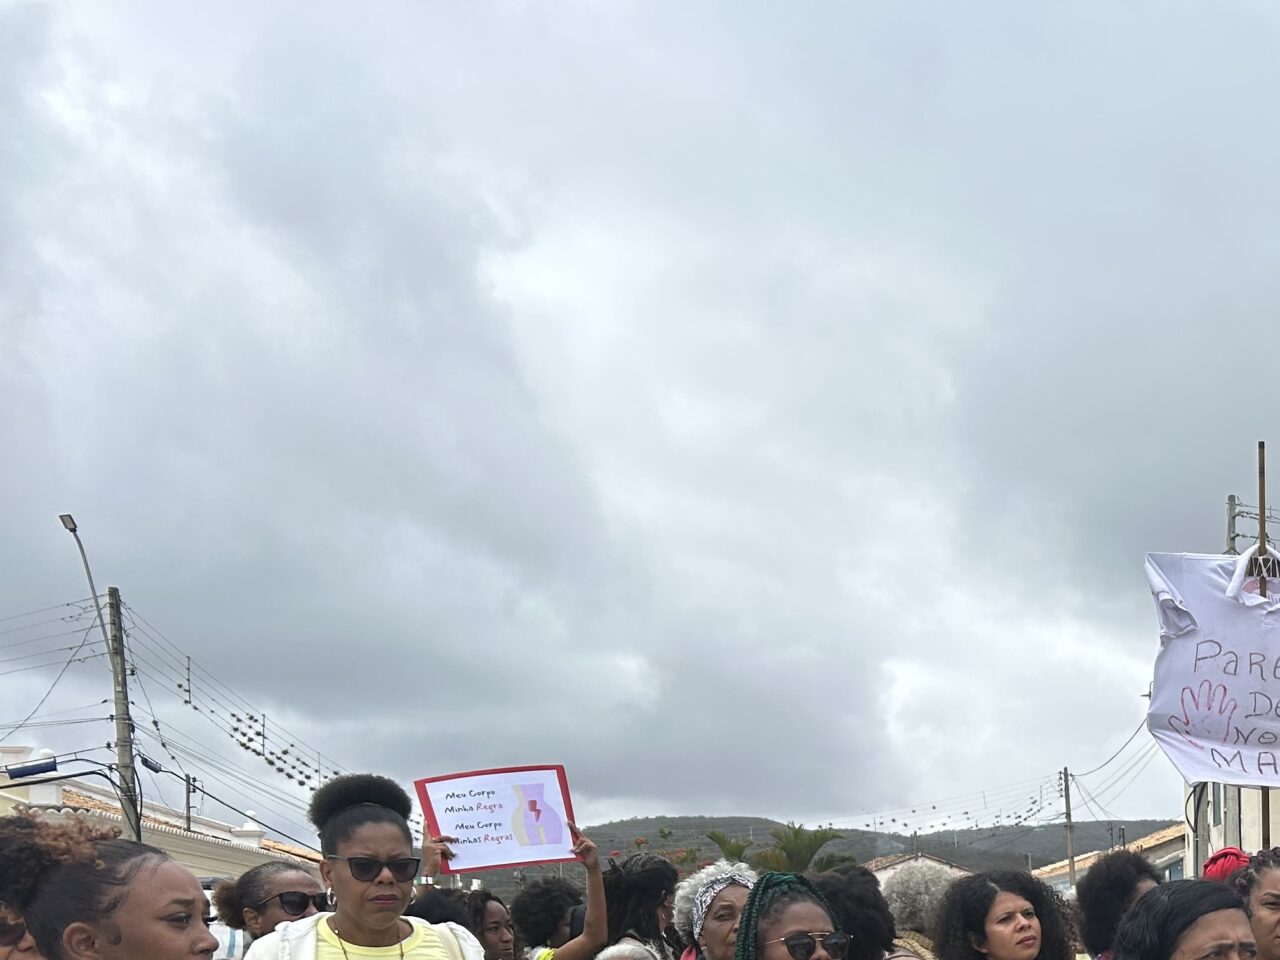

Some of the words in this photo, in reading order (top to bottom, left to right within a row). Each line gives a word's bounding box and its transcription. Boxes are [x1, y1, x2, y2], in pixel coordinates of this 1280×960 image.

[445, 790, 467, 800] Meu
[469, 789, 496, 800] Corpo
[444, 804, 474, 814] Minha
[476, 802, 503, 814] Regra
[455, 822, 475, 831] Meu
[477, 821, 502, 831] Corpo
[484, 833, 513, 843] Regras
